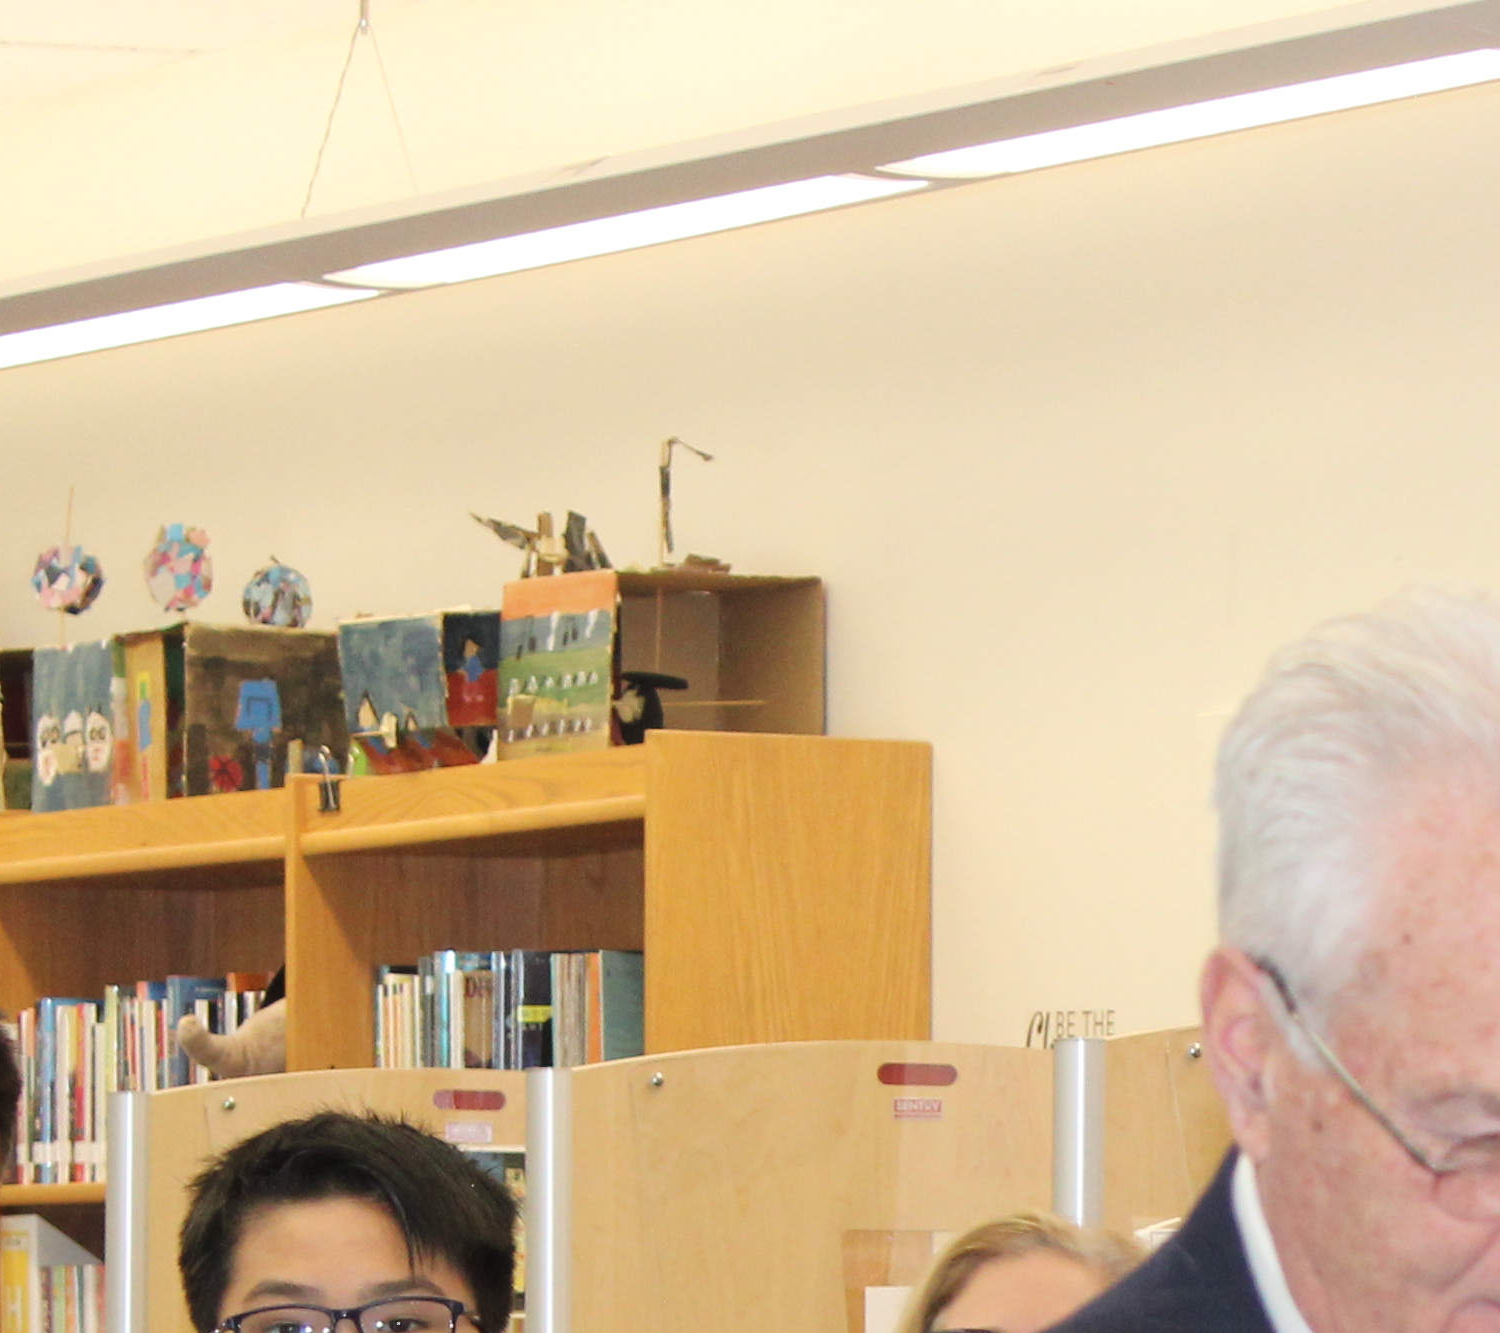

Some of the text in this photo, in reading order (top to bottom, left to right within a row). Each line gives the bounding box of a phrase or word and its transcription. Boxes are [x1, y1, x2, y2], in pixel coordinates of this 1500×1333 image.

[1056, 1011, 1075, 1038] BE
[1082, 1010, 1115, 1036] THE
[896, 1100, 941, 1112] SENTRY
